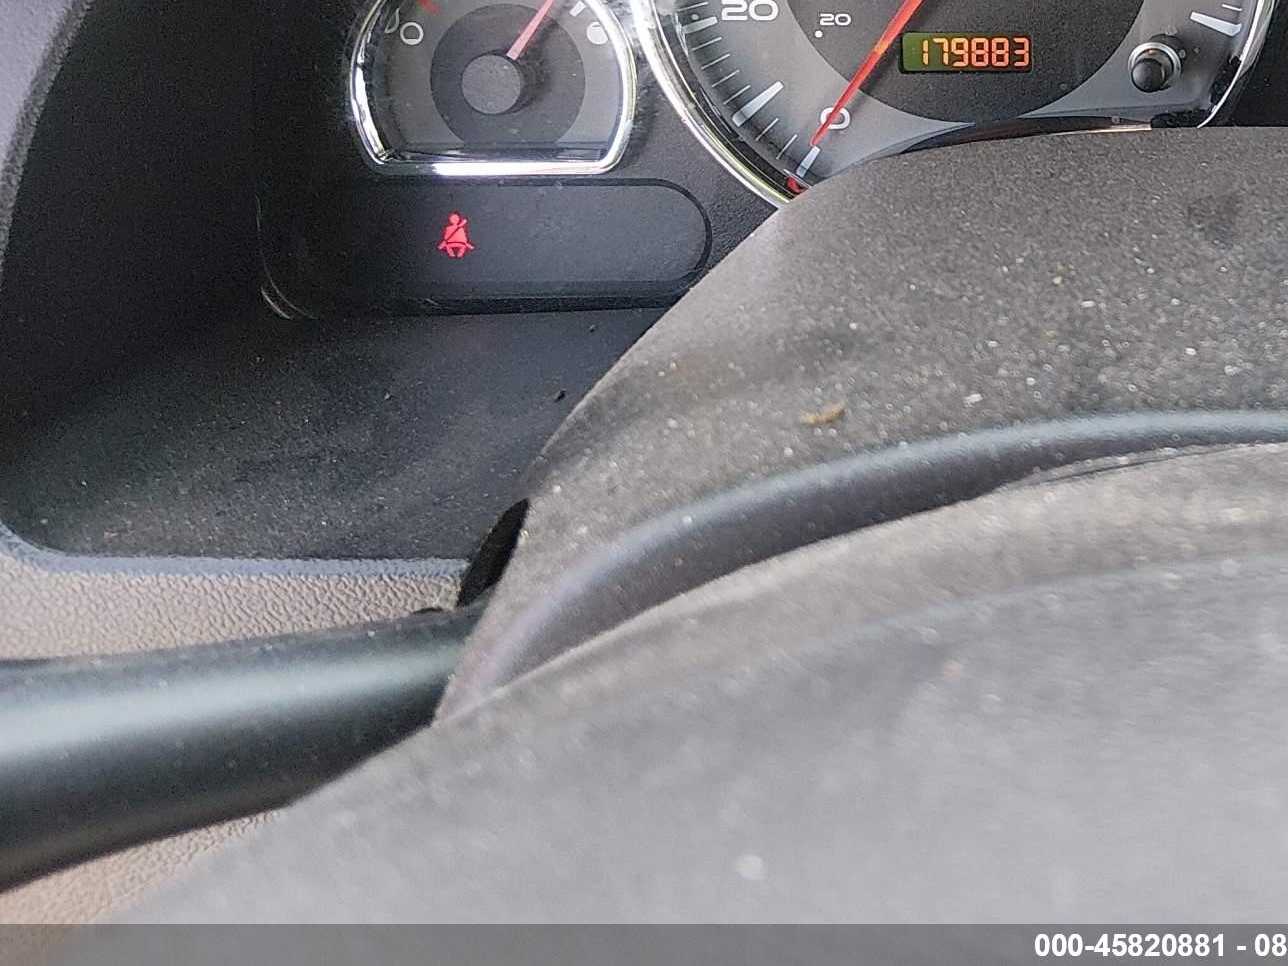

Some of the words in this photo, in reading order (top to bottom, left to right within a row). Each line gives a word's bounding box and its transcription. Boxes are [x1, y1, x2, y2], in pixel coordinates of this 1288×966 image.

[722, 0, 778, 20] 20
[820, 14, 851, 25] 20
[923, 38, 1029, 66] 179883
[820, 107, 850, 129] 0
